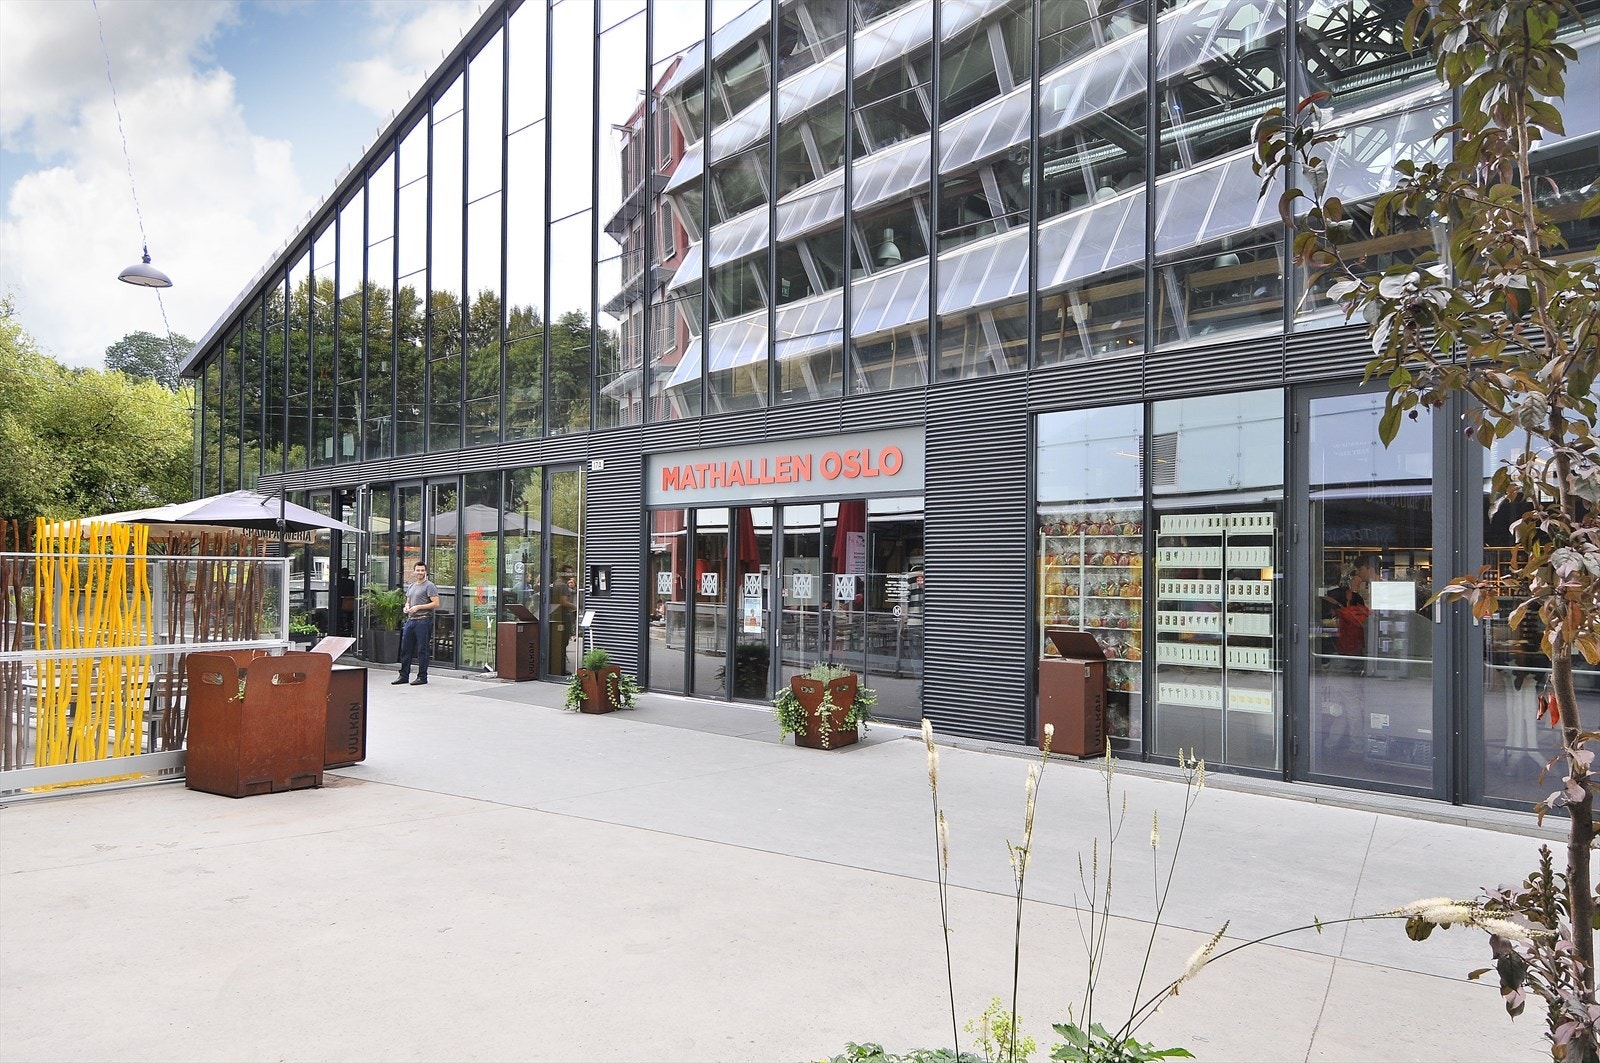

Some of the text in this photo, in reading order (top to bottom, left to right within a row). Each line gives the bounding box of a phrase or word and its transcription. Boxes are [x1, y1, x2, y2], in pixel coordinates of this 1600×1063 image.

[662, 445, 904, 491] MATHALLEN OSLO
[242, 527, 312, 541] CHAMPANERIA
[348, 702, 360, 756] VULKAN
